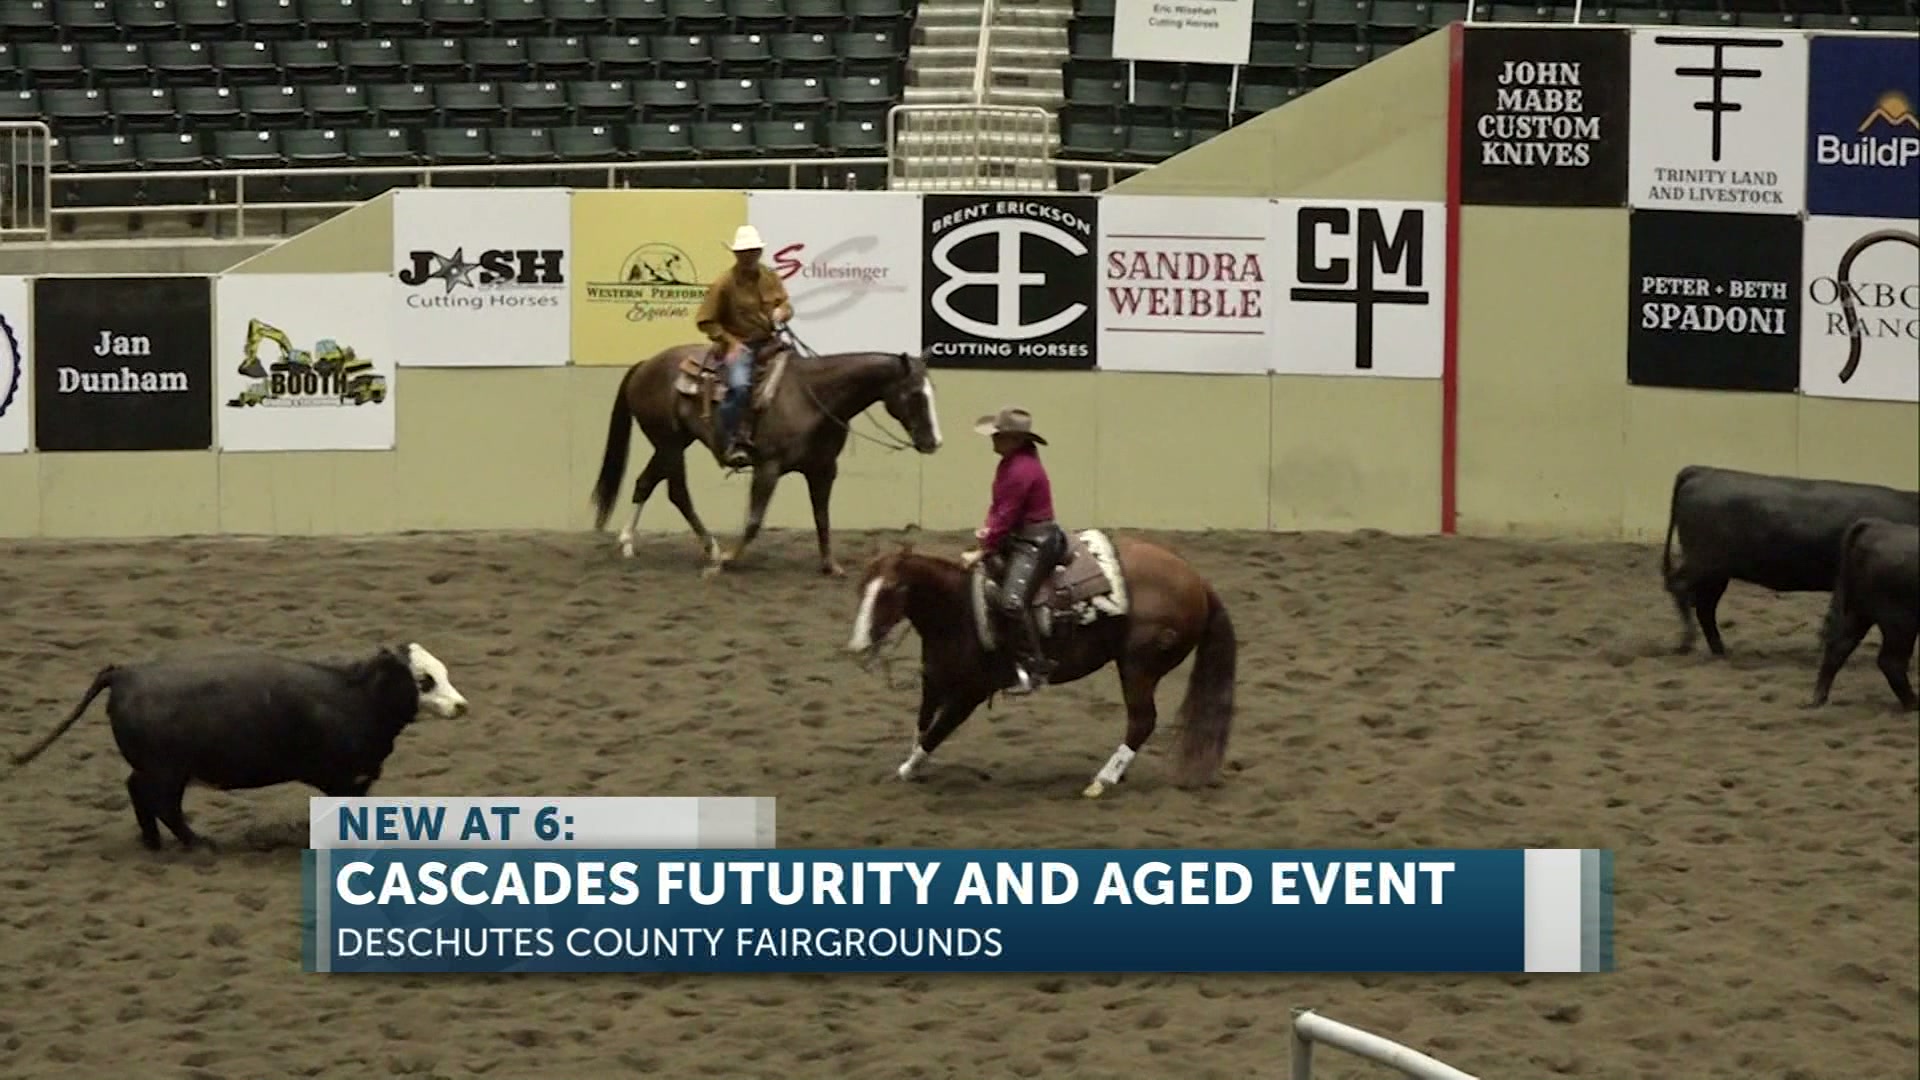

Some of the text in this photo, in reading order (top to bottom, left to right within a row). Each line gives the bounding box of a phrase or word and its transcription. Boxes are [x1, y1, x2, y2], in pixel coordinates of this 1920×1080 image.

[1498, 61, 1581, 86] JOHN
[1496, 88, 1583, 113] MABE
[1477, 114, 1601, 141] CUSTOM
[1482, 141, 1590, 167] KNIVES
[1654, 167, 1778, 186] TRINITY LAND
[1648, 185, 1784, 205] AND LIVESTOCK
[931, 201, 1091, 235] BRENT ERICKSON
[1107, 250, 1265, 284] SANDRA
[586, 287, 643, 298] WESTERN
[1642, 276, 1711, 297] PETER
[1729, 279, 1788, 300] BETH
[406, 294, 559, 310] Cutting Horses
[1107, 286, 1263, 319] WEIBLE
[1642, 302, 1787, 336] SPADONI
[93, 330, 151, 357] Jan
[930, 342, 1090, 358] CUTTING HORSES
[58, 366, 189, 394] Dunham
[271, 372, 347, 395] BOOTH
